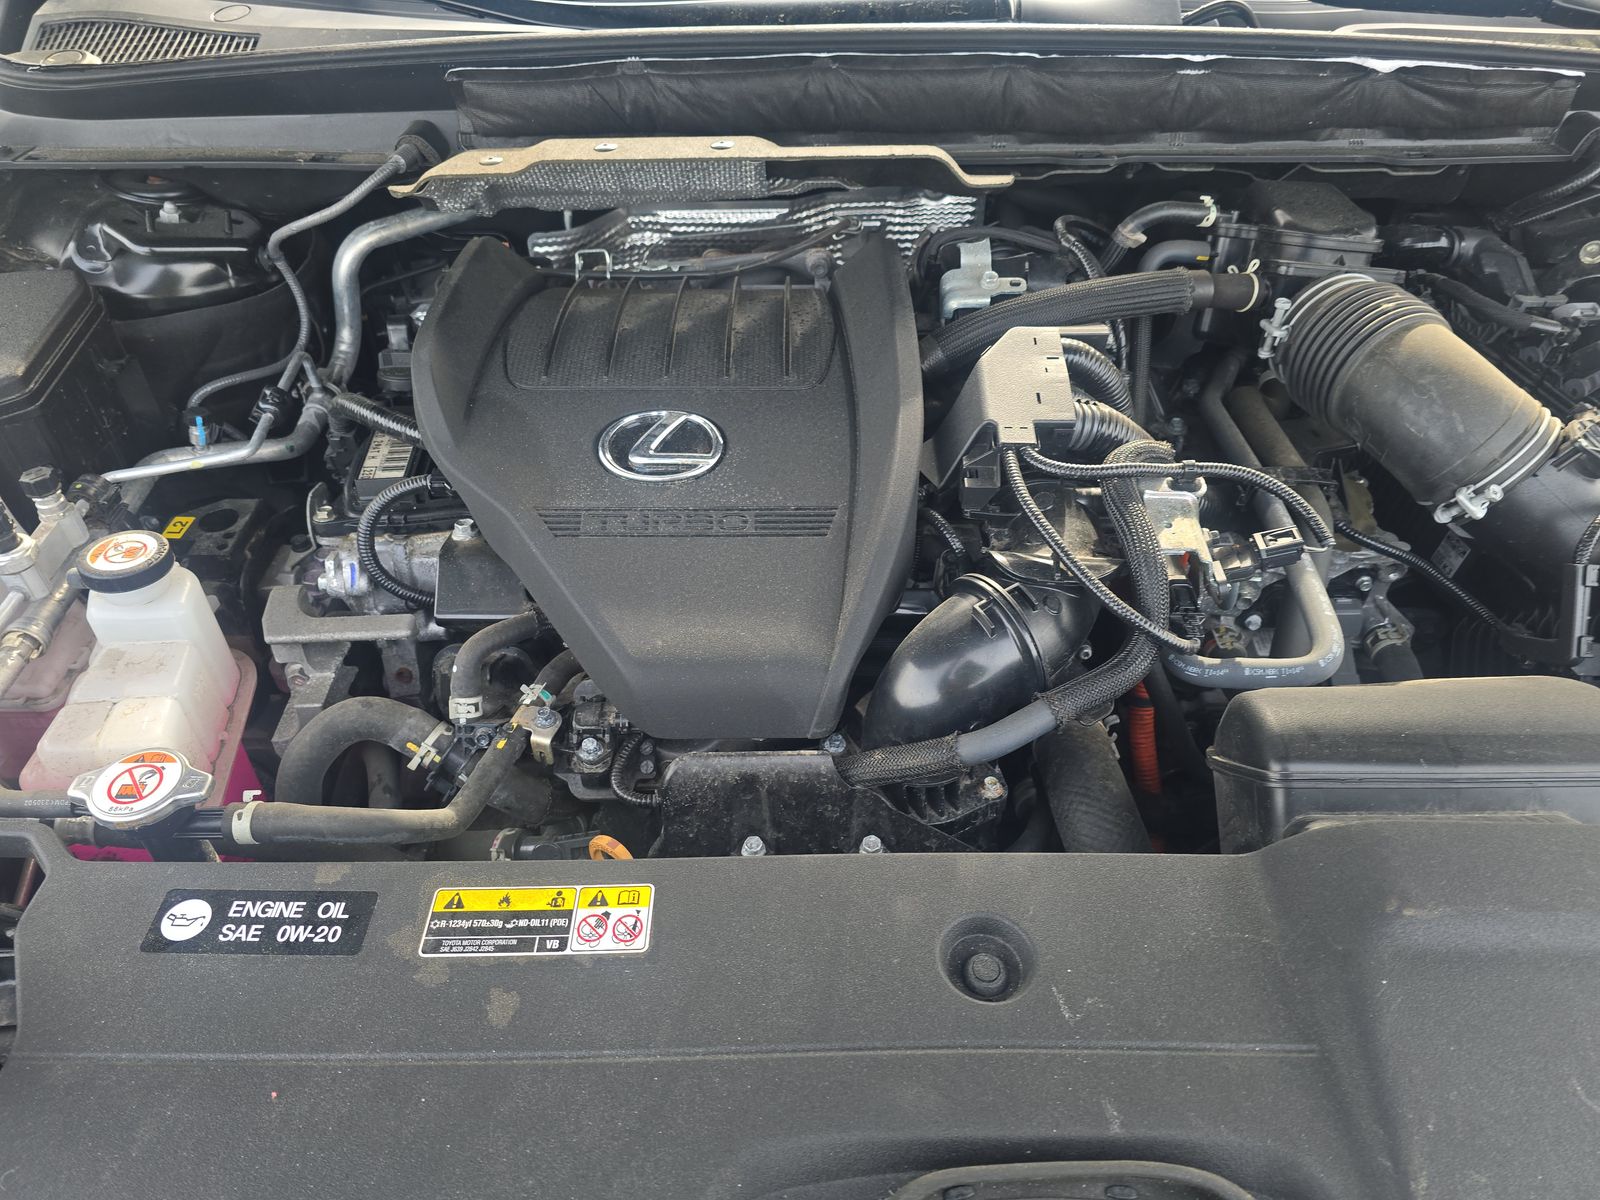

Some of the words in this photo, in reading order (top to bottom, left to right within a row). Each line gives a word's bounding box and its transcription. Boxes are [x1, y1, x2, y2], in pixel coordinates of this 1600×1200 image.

[167, 520, 189, 534] L2
[583, 511, 751, 532] TURBO
[228, 900, 306, 918] ENGINE
[317, 902, 350, 919] OIL
[440, 919, 472, 929] R-1234yf
[518, 918, 549, 927] ND-OIL11
[550, 918, 569, 928] (POE)
[218, 924, 264, 942] SAE
[276, 926, 342, 943] 0W-20
[481, 938, 518, 946] CORPORATION
[546, 939, 559, 949] VB
